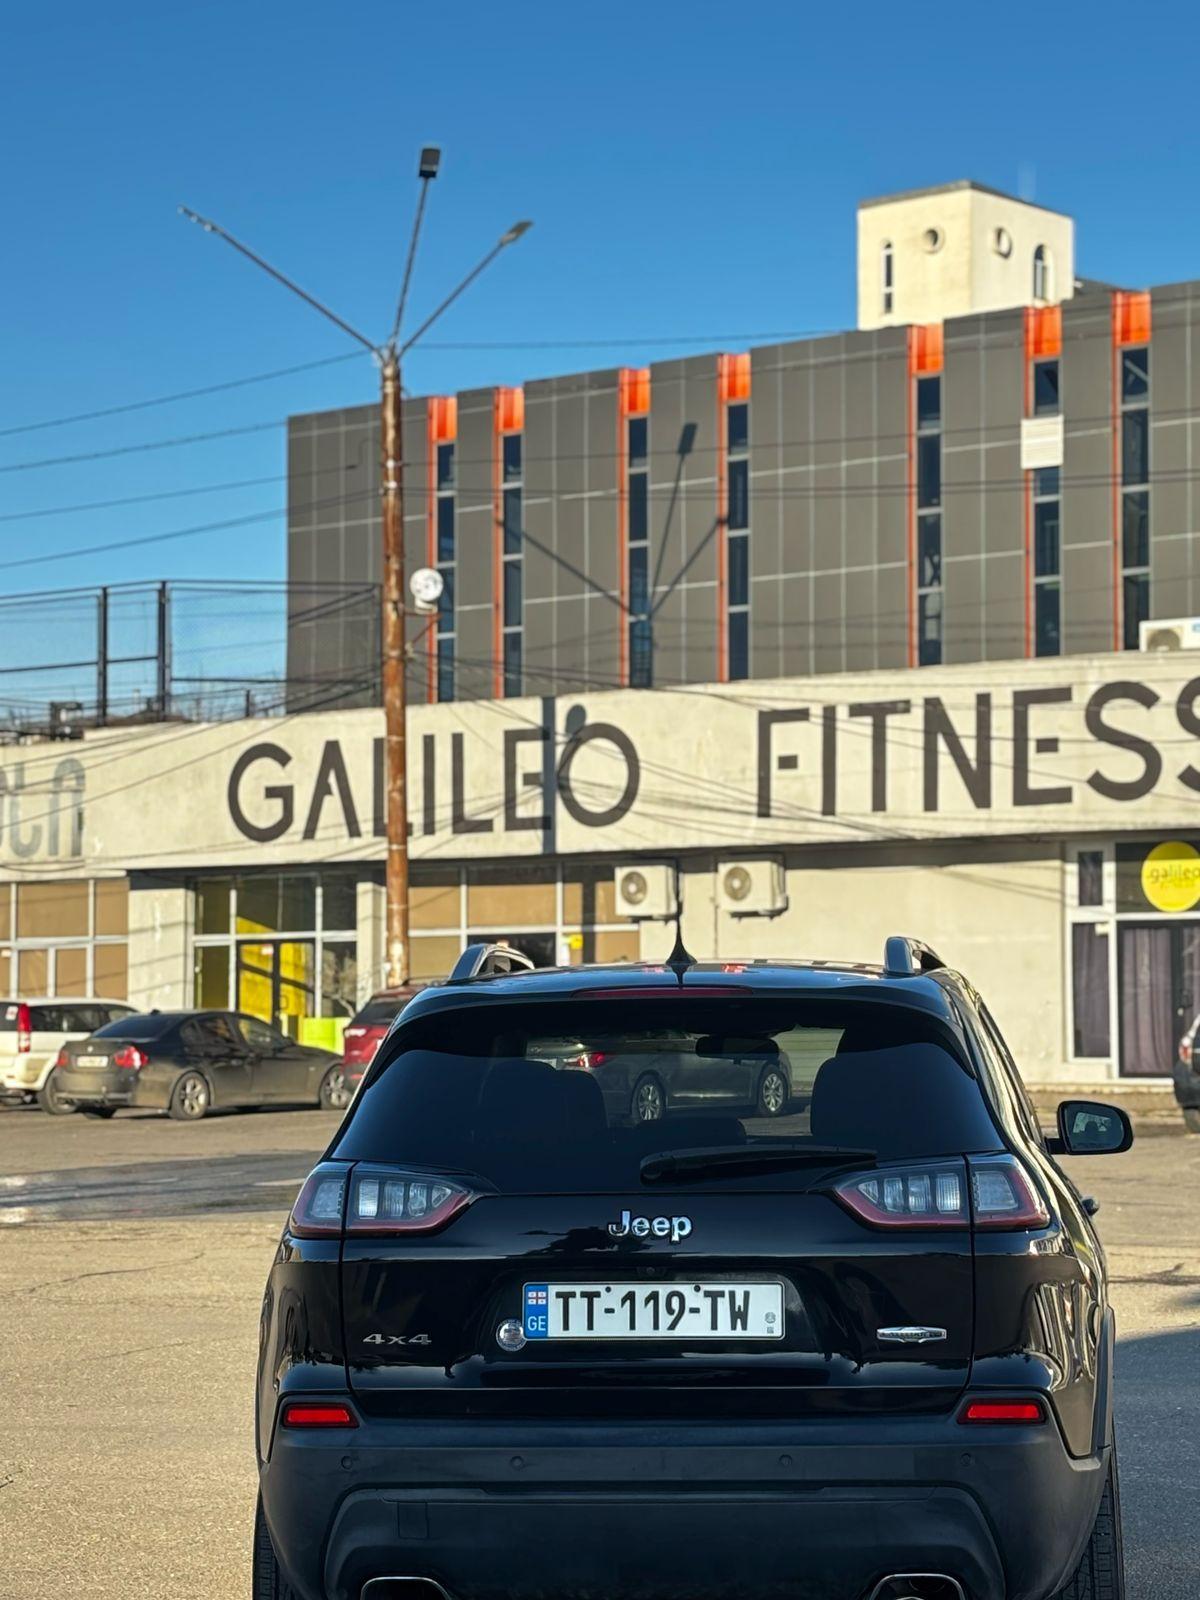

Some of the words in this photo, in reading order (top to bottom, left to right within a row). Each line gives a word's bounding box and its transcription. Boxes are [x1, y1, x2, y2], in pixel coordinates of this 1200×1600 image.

[228, 721, 641, 843] GALILEO
[608, 1210, 693, 1242] Jeep
[527, 1315, 547, 1332] GE
[555, 1289, 751, 1332] TT-119-TW
[362, 1333, 433, 1345] 4x4
